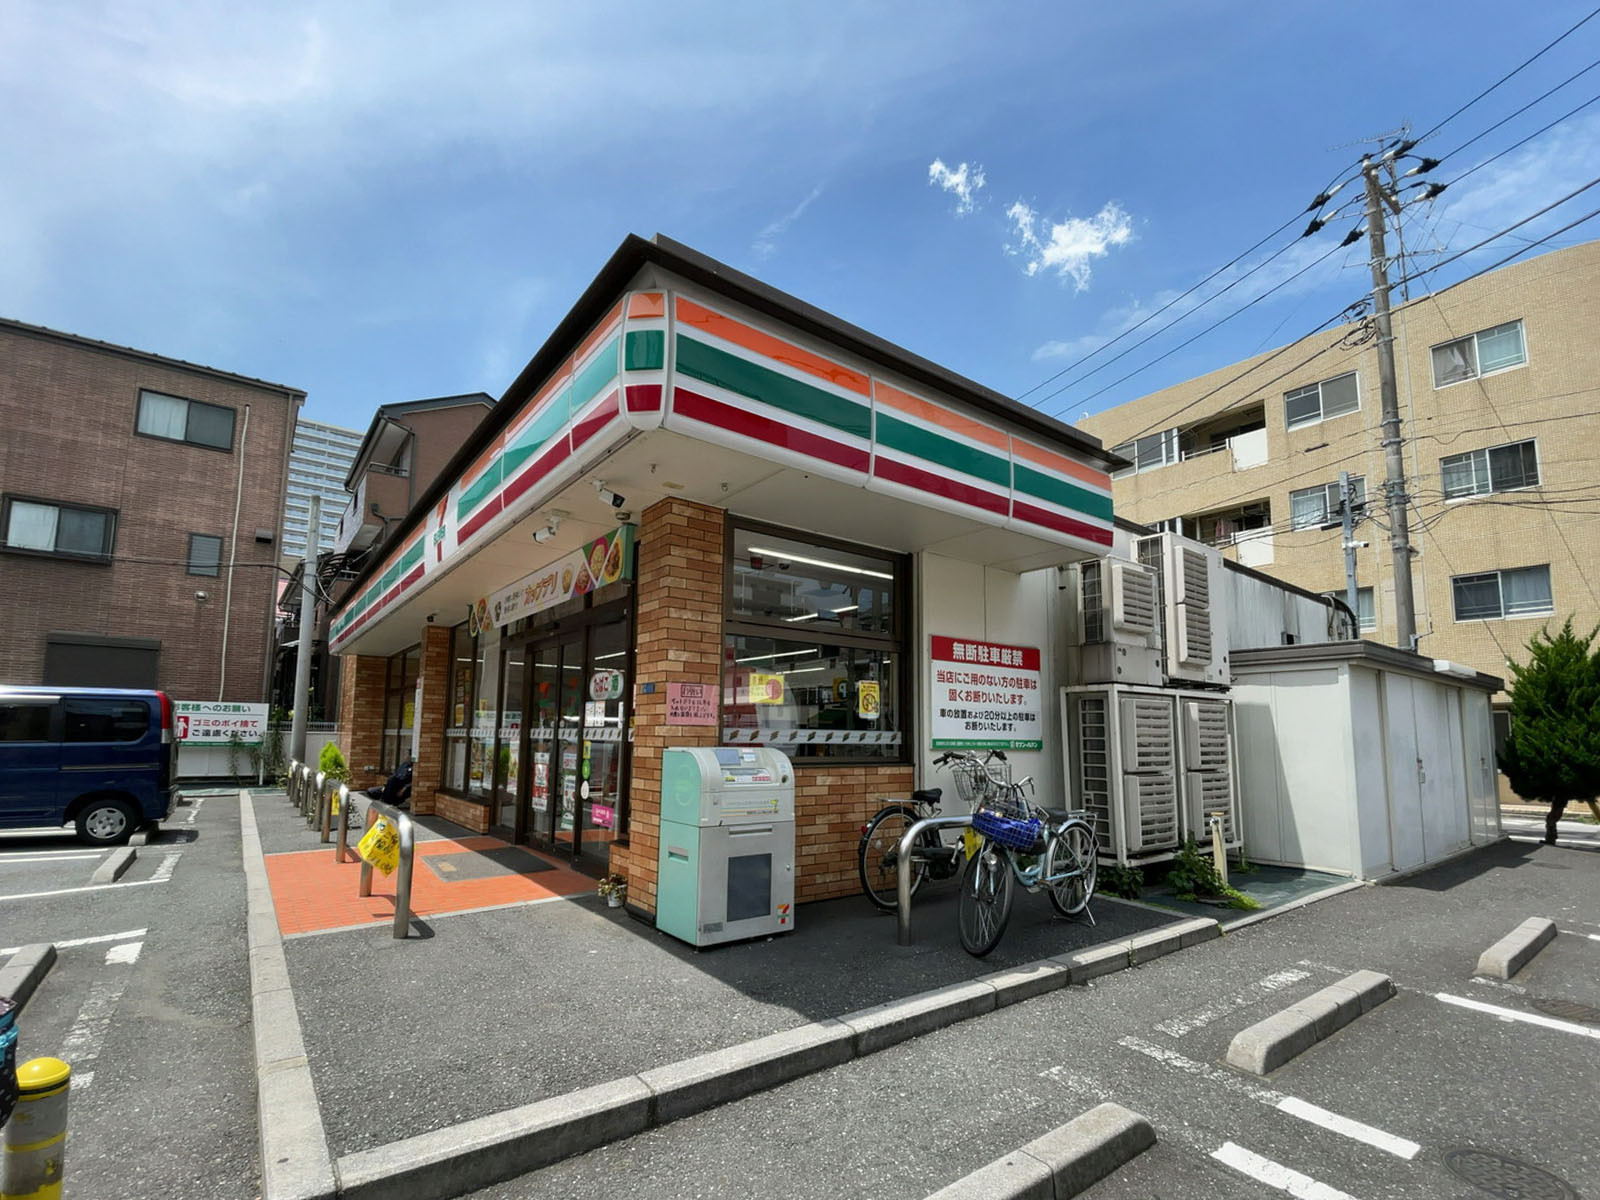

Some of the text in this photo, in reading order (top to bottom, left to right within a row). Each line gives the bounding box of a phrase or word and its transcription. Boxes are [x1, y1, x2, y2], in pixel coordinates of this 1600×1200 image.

[952, 642, 1023, 666] 無断駐車厳禁
[937, 670, 1036, 689] 当店にご用のない方の駐車は
[948, 688, 1027, 706] 固くお断りいたします。
[939, 708, 1036, 722] 車の放置および20分以上の駐車は
[193, 719, 259, 728] ゴミのポイ捨て
[965, 721, 1017, 733] お断りいたします。
